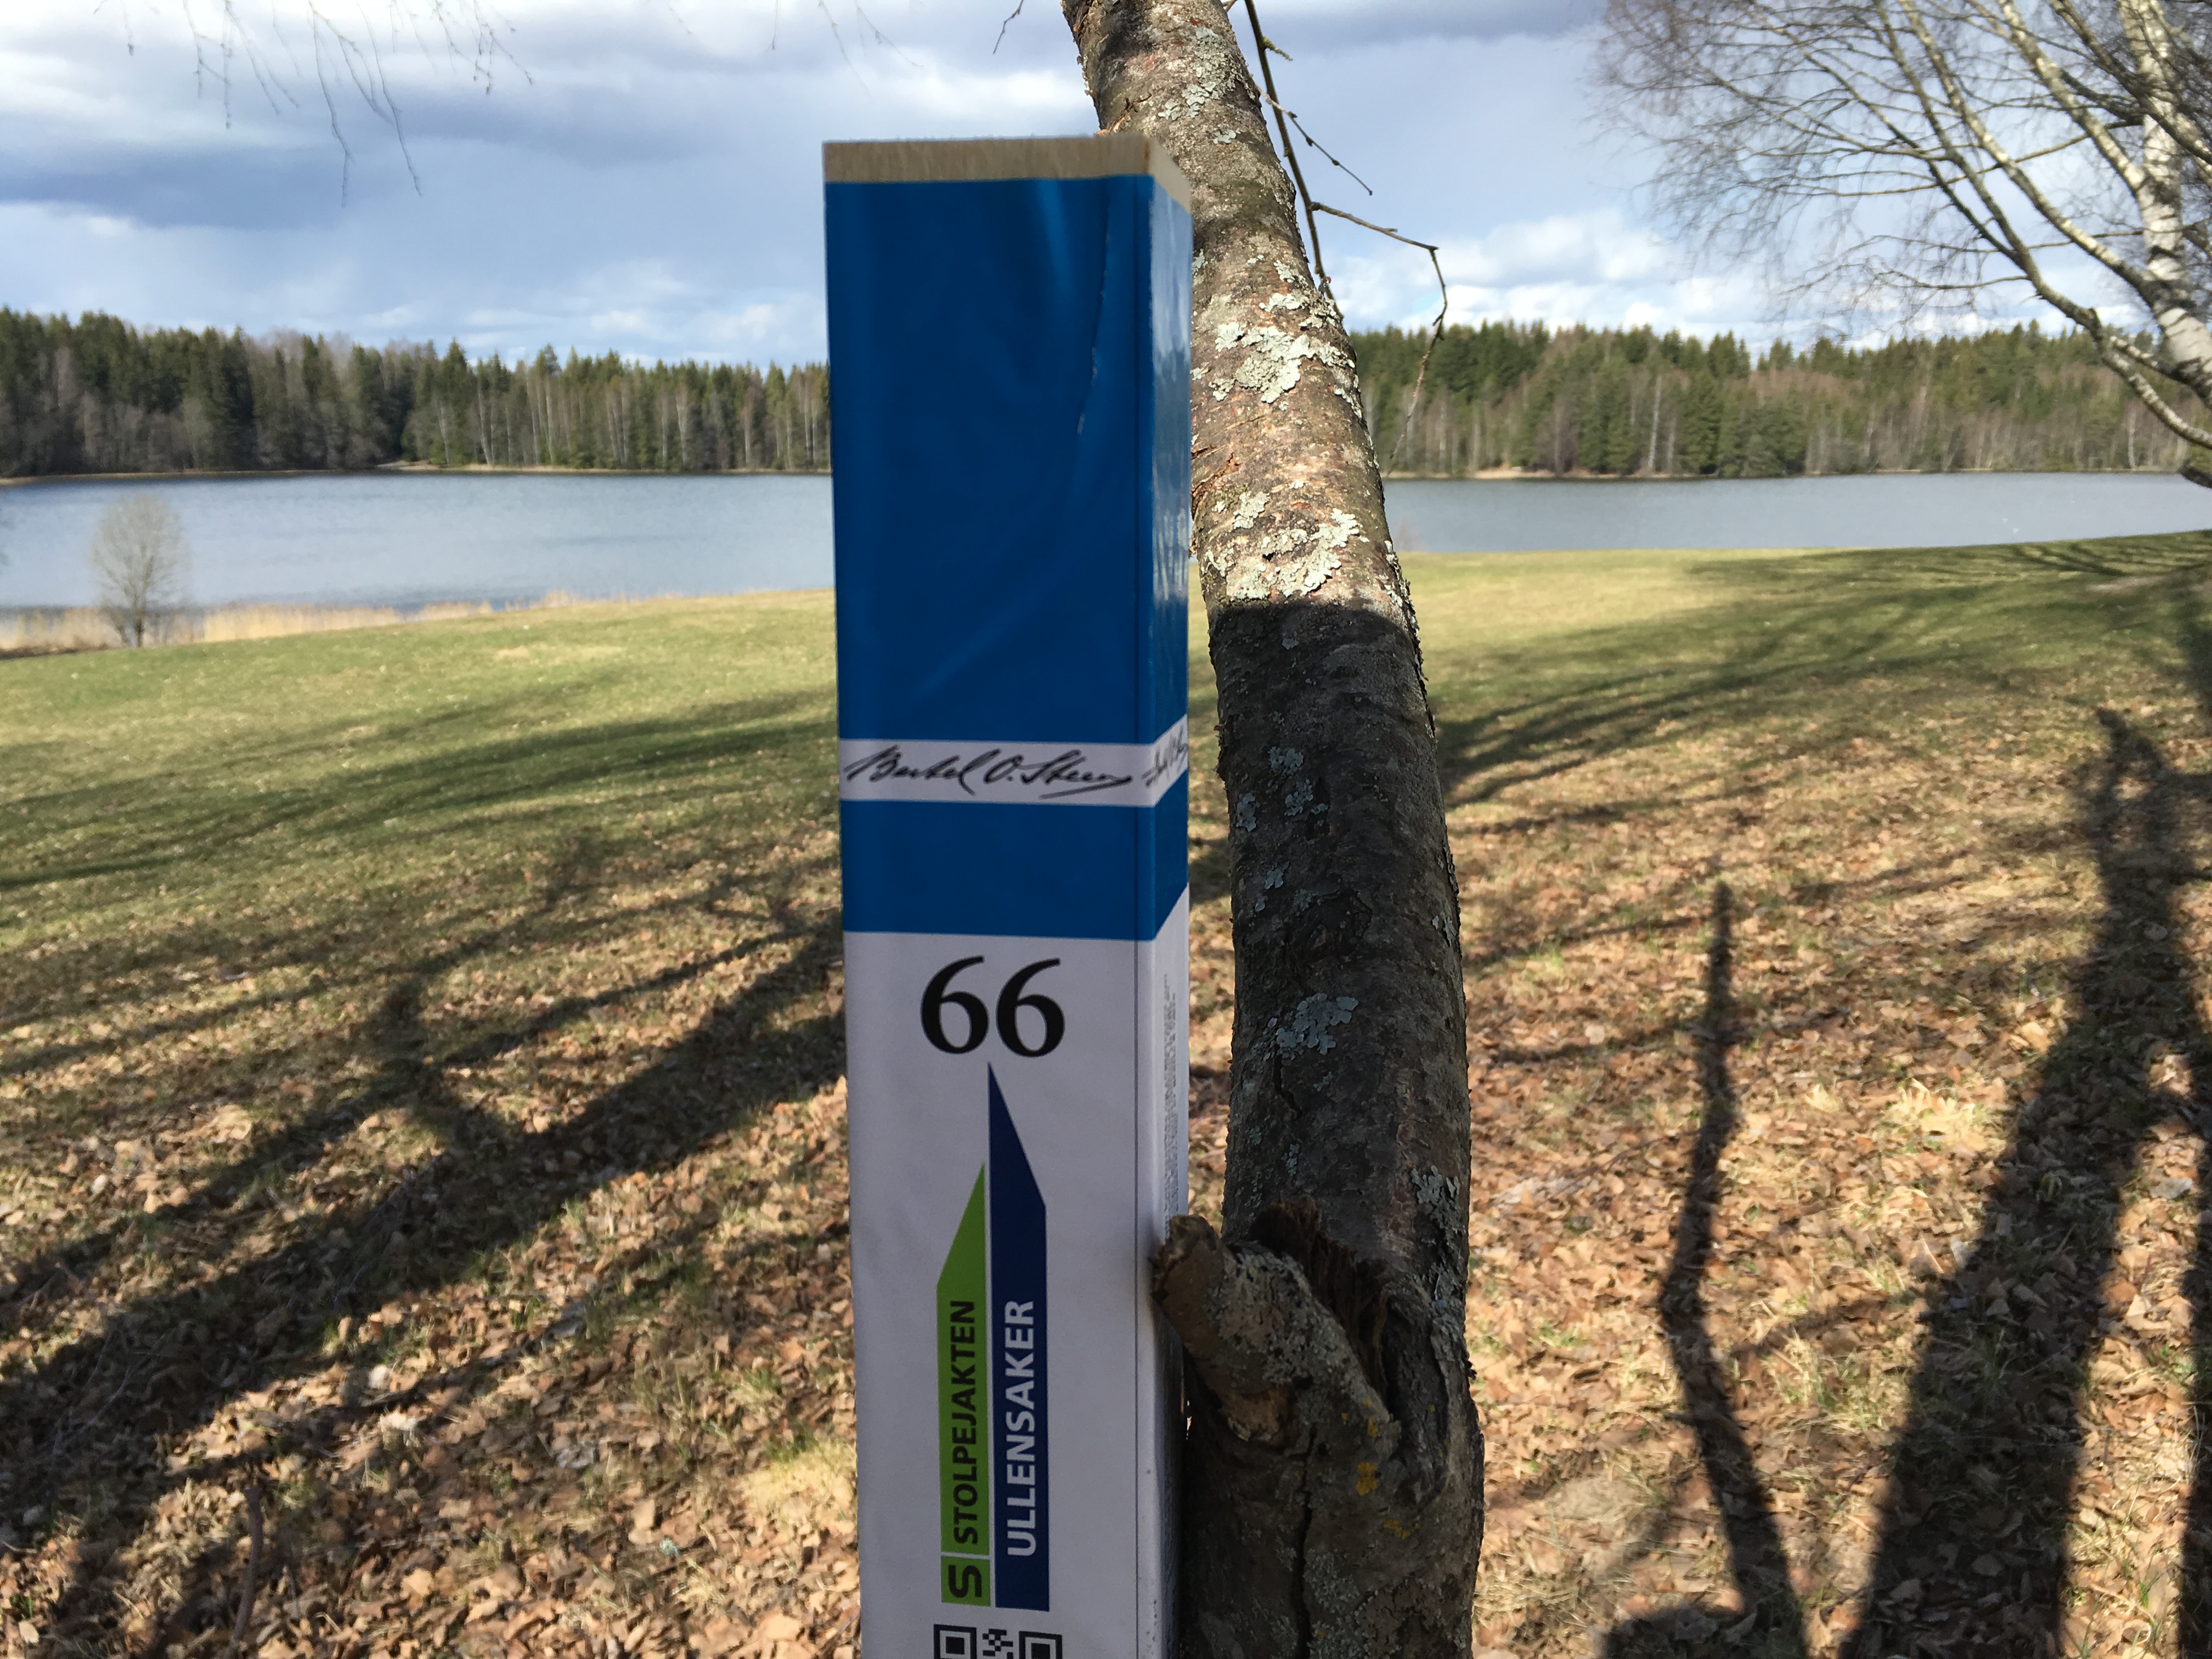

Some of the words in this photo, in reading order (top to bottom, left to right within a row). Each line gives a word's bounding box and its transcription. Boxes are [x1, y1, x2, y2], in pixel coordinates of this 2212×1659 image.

[921, 955, 1065, 1058] 66
[949, 1300, 979, 1546] STOLPEJAKTEN
[1004, 1300, 1036, 1556] ULLENSAKER
